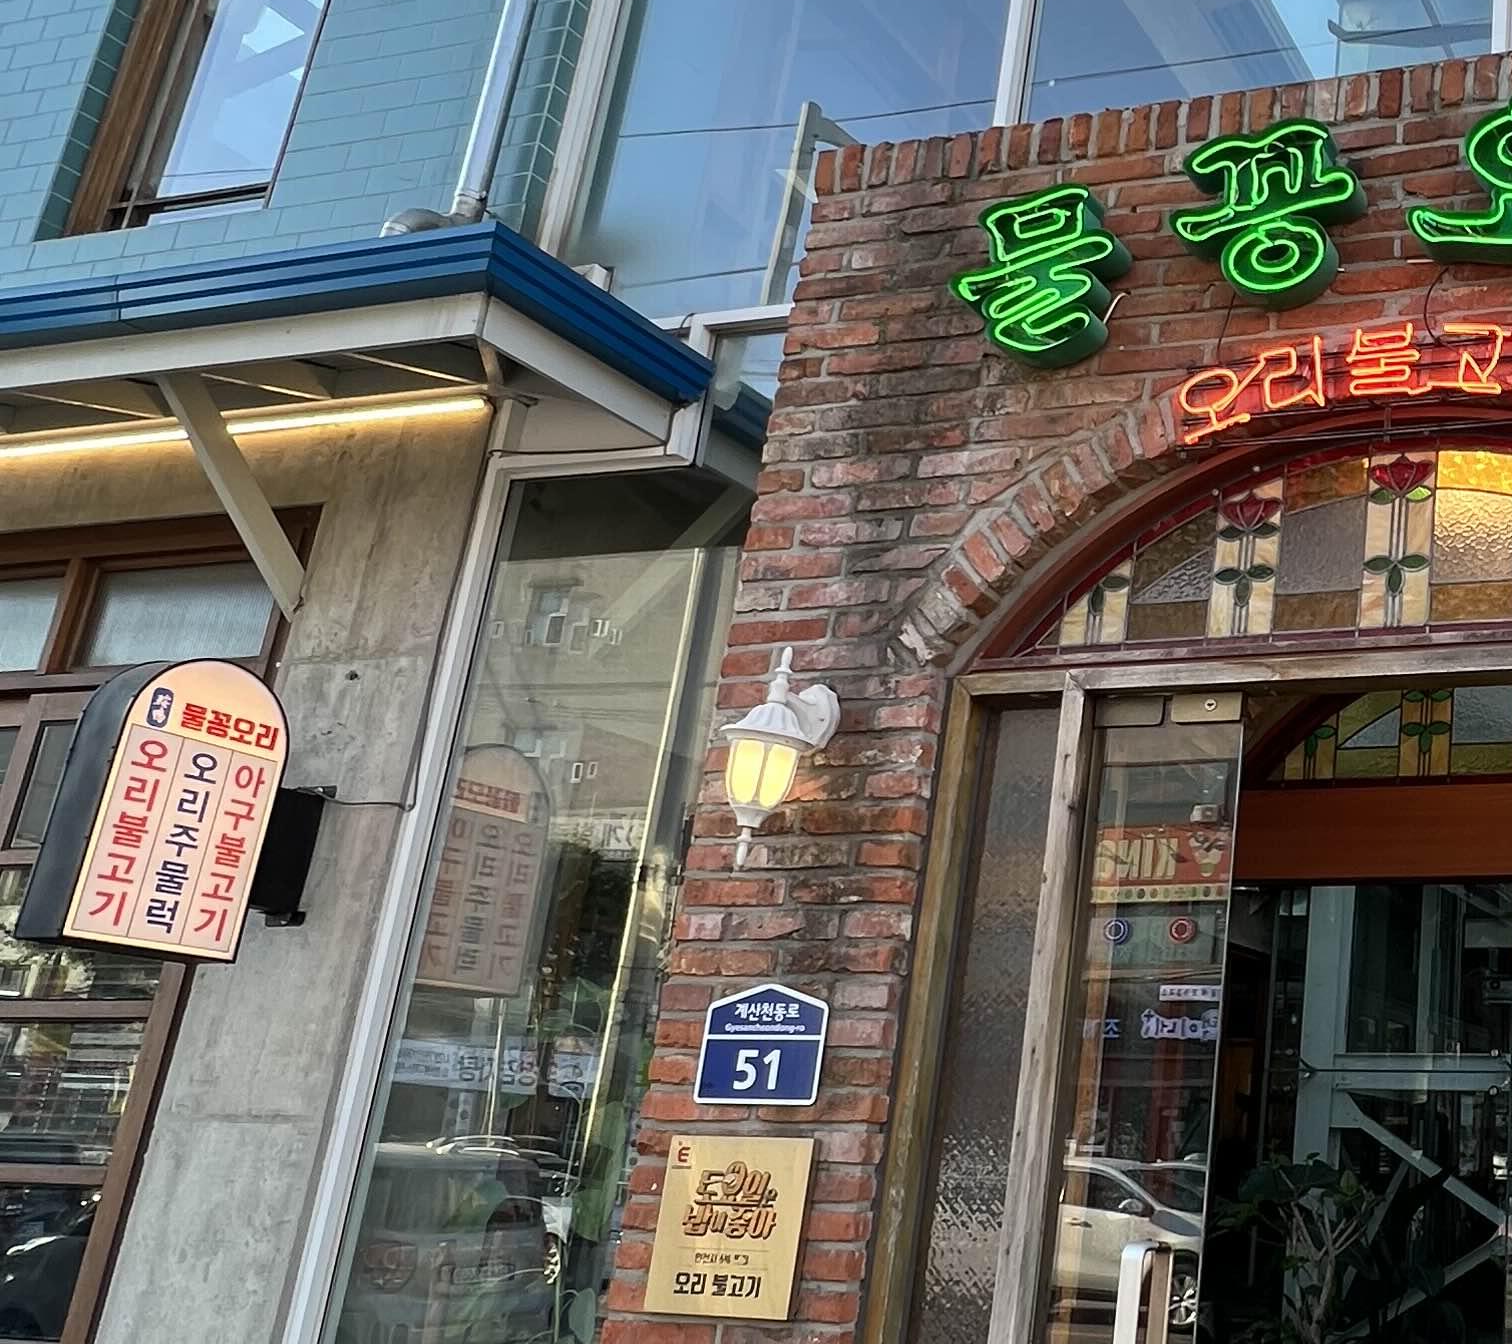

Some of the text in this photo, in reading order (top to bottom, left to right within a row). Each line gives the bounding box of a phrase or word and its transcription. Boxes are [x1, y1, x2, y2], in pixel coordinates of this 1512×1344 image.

[180, 702, 280, 752] 물꽁오리
[88, 739, 170, 927] 오리불고기
[144, 752, 219, 934] 오리주물럭
[193, 764, 266, 942] 아구불고기
[734, 1002, 801, 1022] 계산천동로
[732, 1048, 782, 1091] 51
[673, 1271, 762, 1298] 오리 불고기
